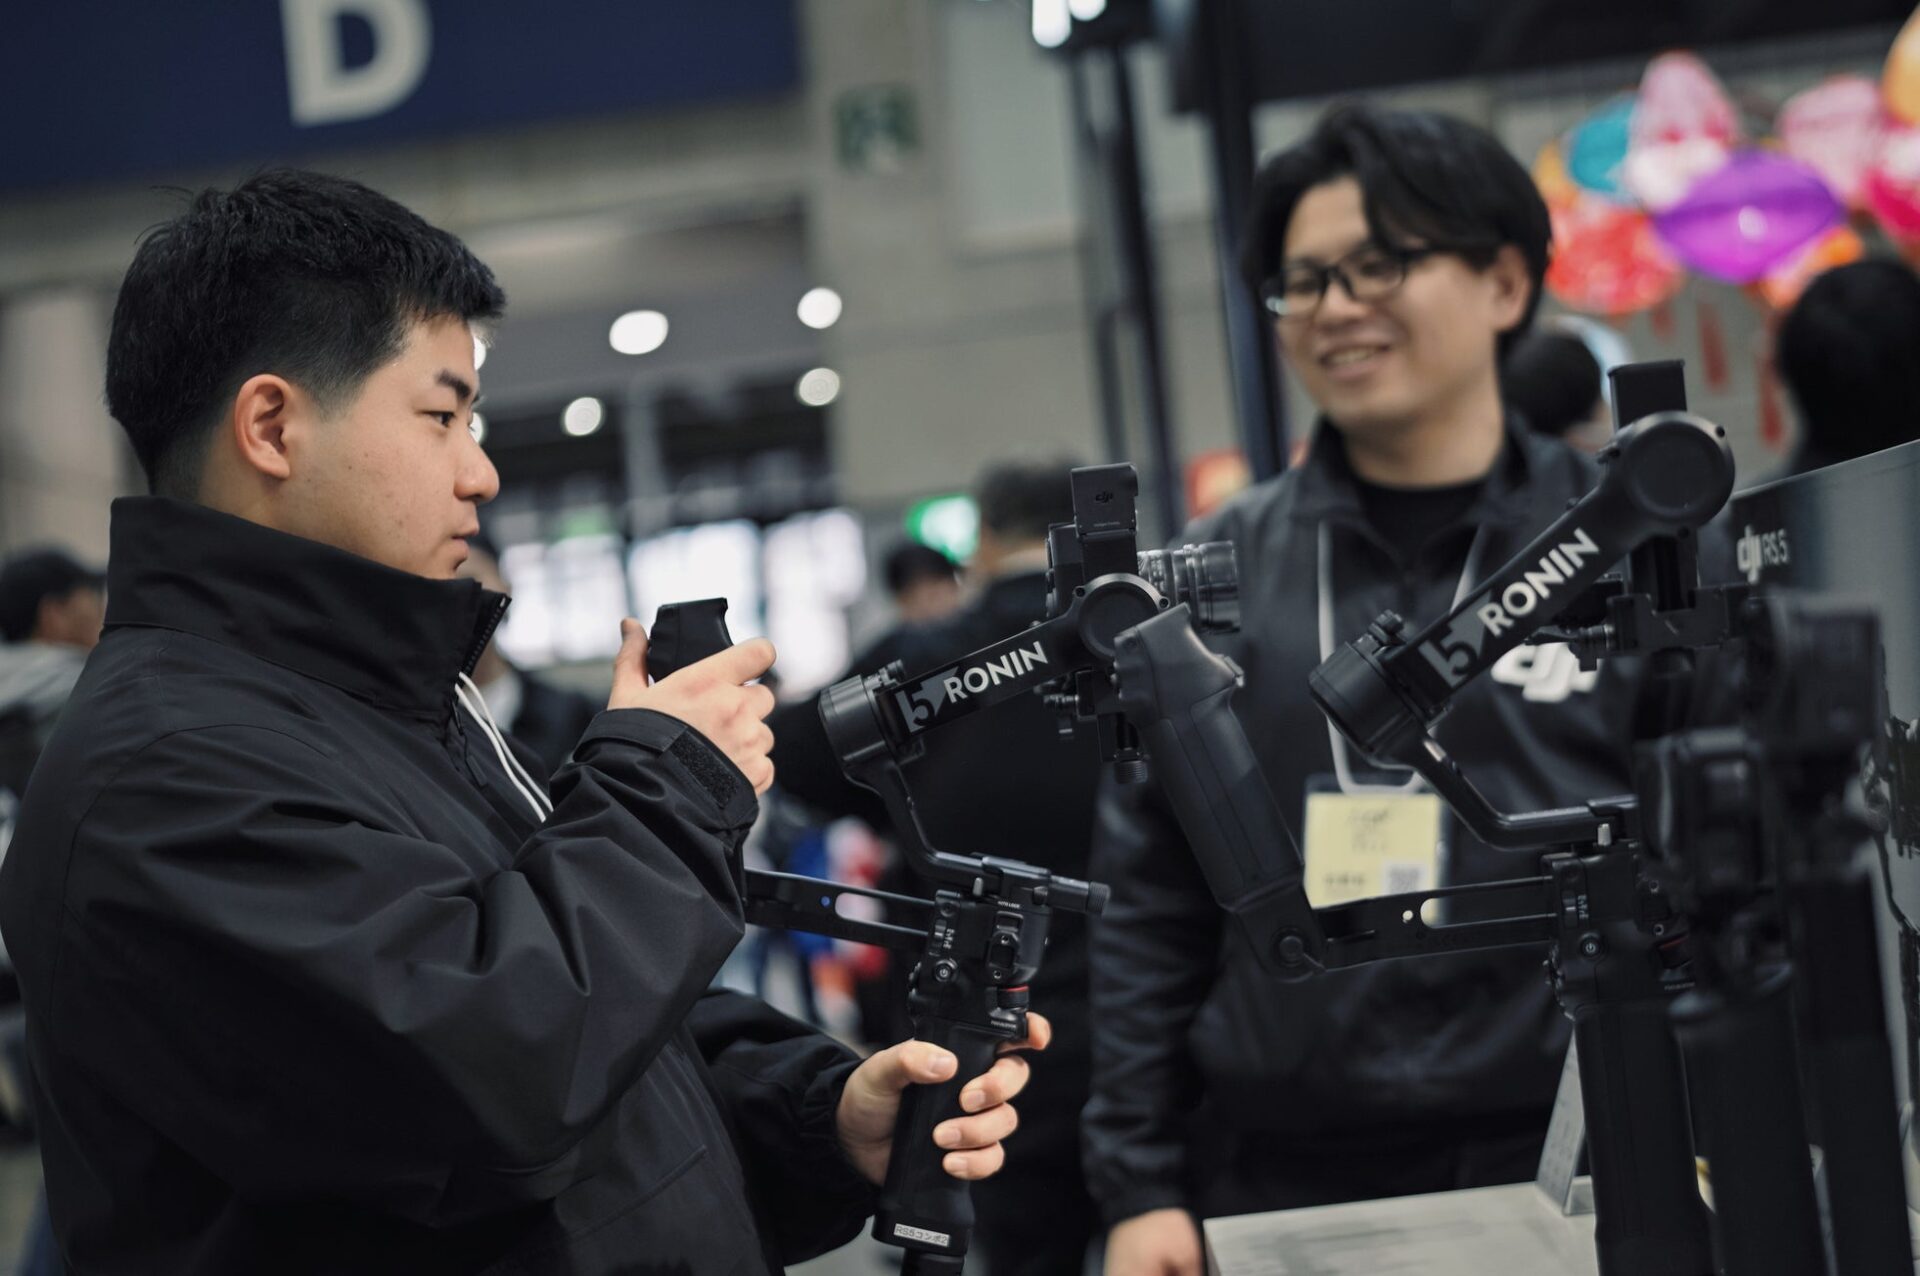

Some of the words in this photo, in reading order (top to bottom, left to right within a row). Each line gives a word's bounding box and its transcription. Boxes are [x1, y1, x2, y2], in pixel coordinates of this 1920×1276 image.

[281, 0, 432, 126] D
[1477, 527, 1600, 638] RONIN
[943, 641, 1049, 704] RONIN
